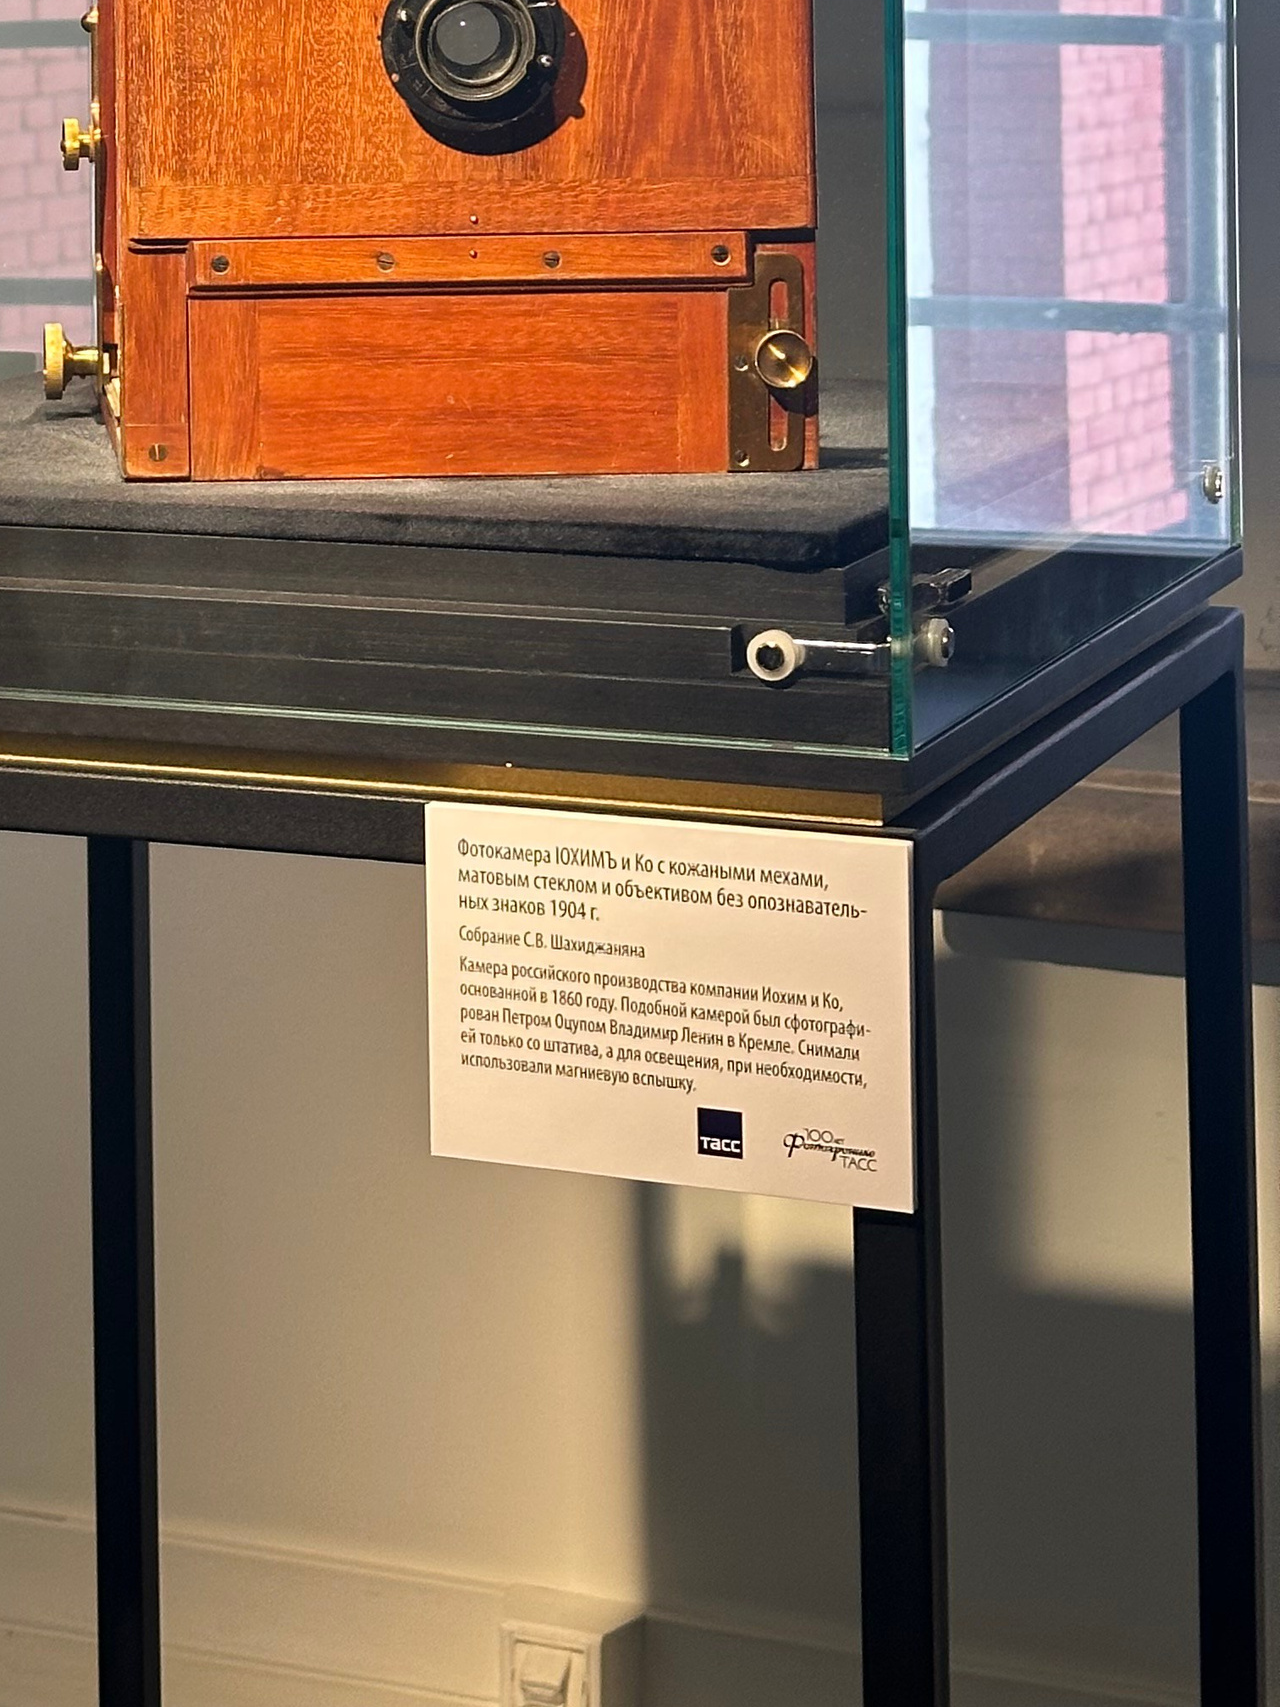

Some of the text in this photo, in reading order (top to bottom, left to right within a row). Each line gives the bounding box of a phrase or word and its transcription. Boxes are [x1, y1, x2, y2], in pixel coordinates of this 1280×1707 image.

[458, 838, 551, 866] Фотокамера
[622, 857, 630, 870] и
[635, 853, 653, 872] Ко
[658, 860, 665, 874] с
[669, 861, 755, 882] кожаными
[760, 870, 829, 891] мехами,
[458, 869, 868, 918] матовым стеклом и объективом без опознаватель-
[459, 895, 600, 921] ных знаков 1904 г.
[459, 925, 646, 959] Собрание С.В. Шахиджаняна
[460, 956, 843, 1012] Камера российского производства компании Иохим и Ко,
[460, 983, 871, 1039] основанной в 1860 году. Подобной камерой был сфотографи-
[461, 1006, 860, 1061] рован Петром Оцупом Владимир Ленин в Кремле. Снимали
[461, 1028, 867, 1089] ей только со штатива, а для освещения, при необходимости,
[461, 1054, 697, 1094] использовали магниевую вспышку.
[839, 1155, 877, 1172] ТАСС
